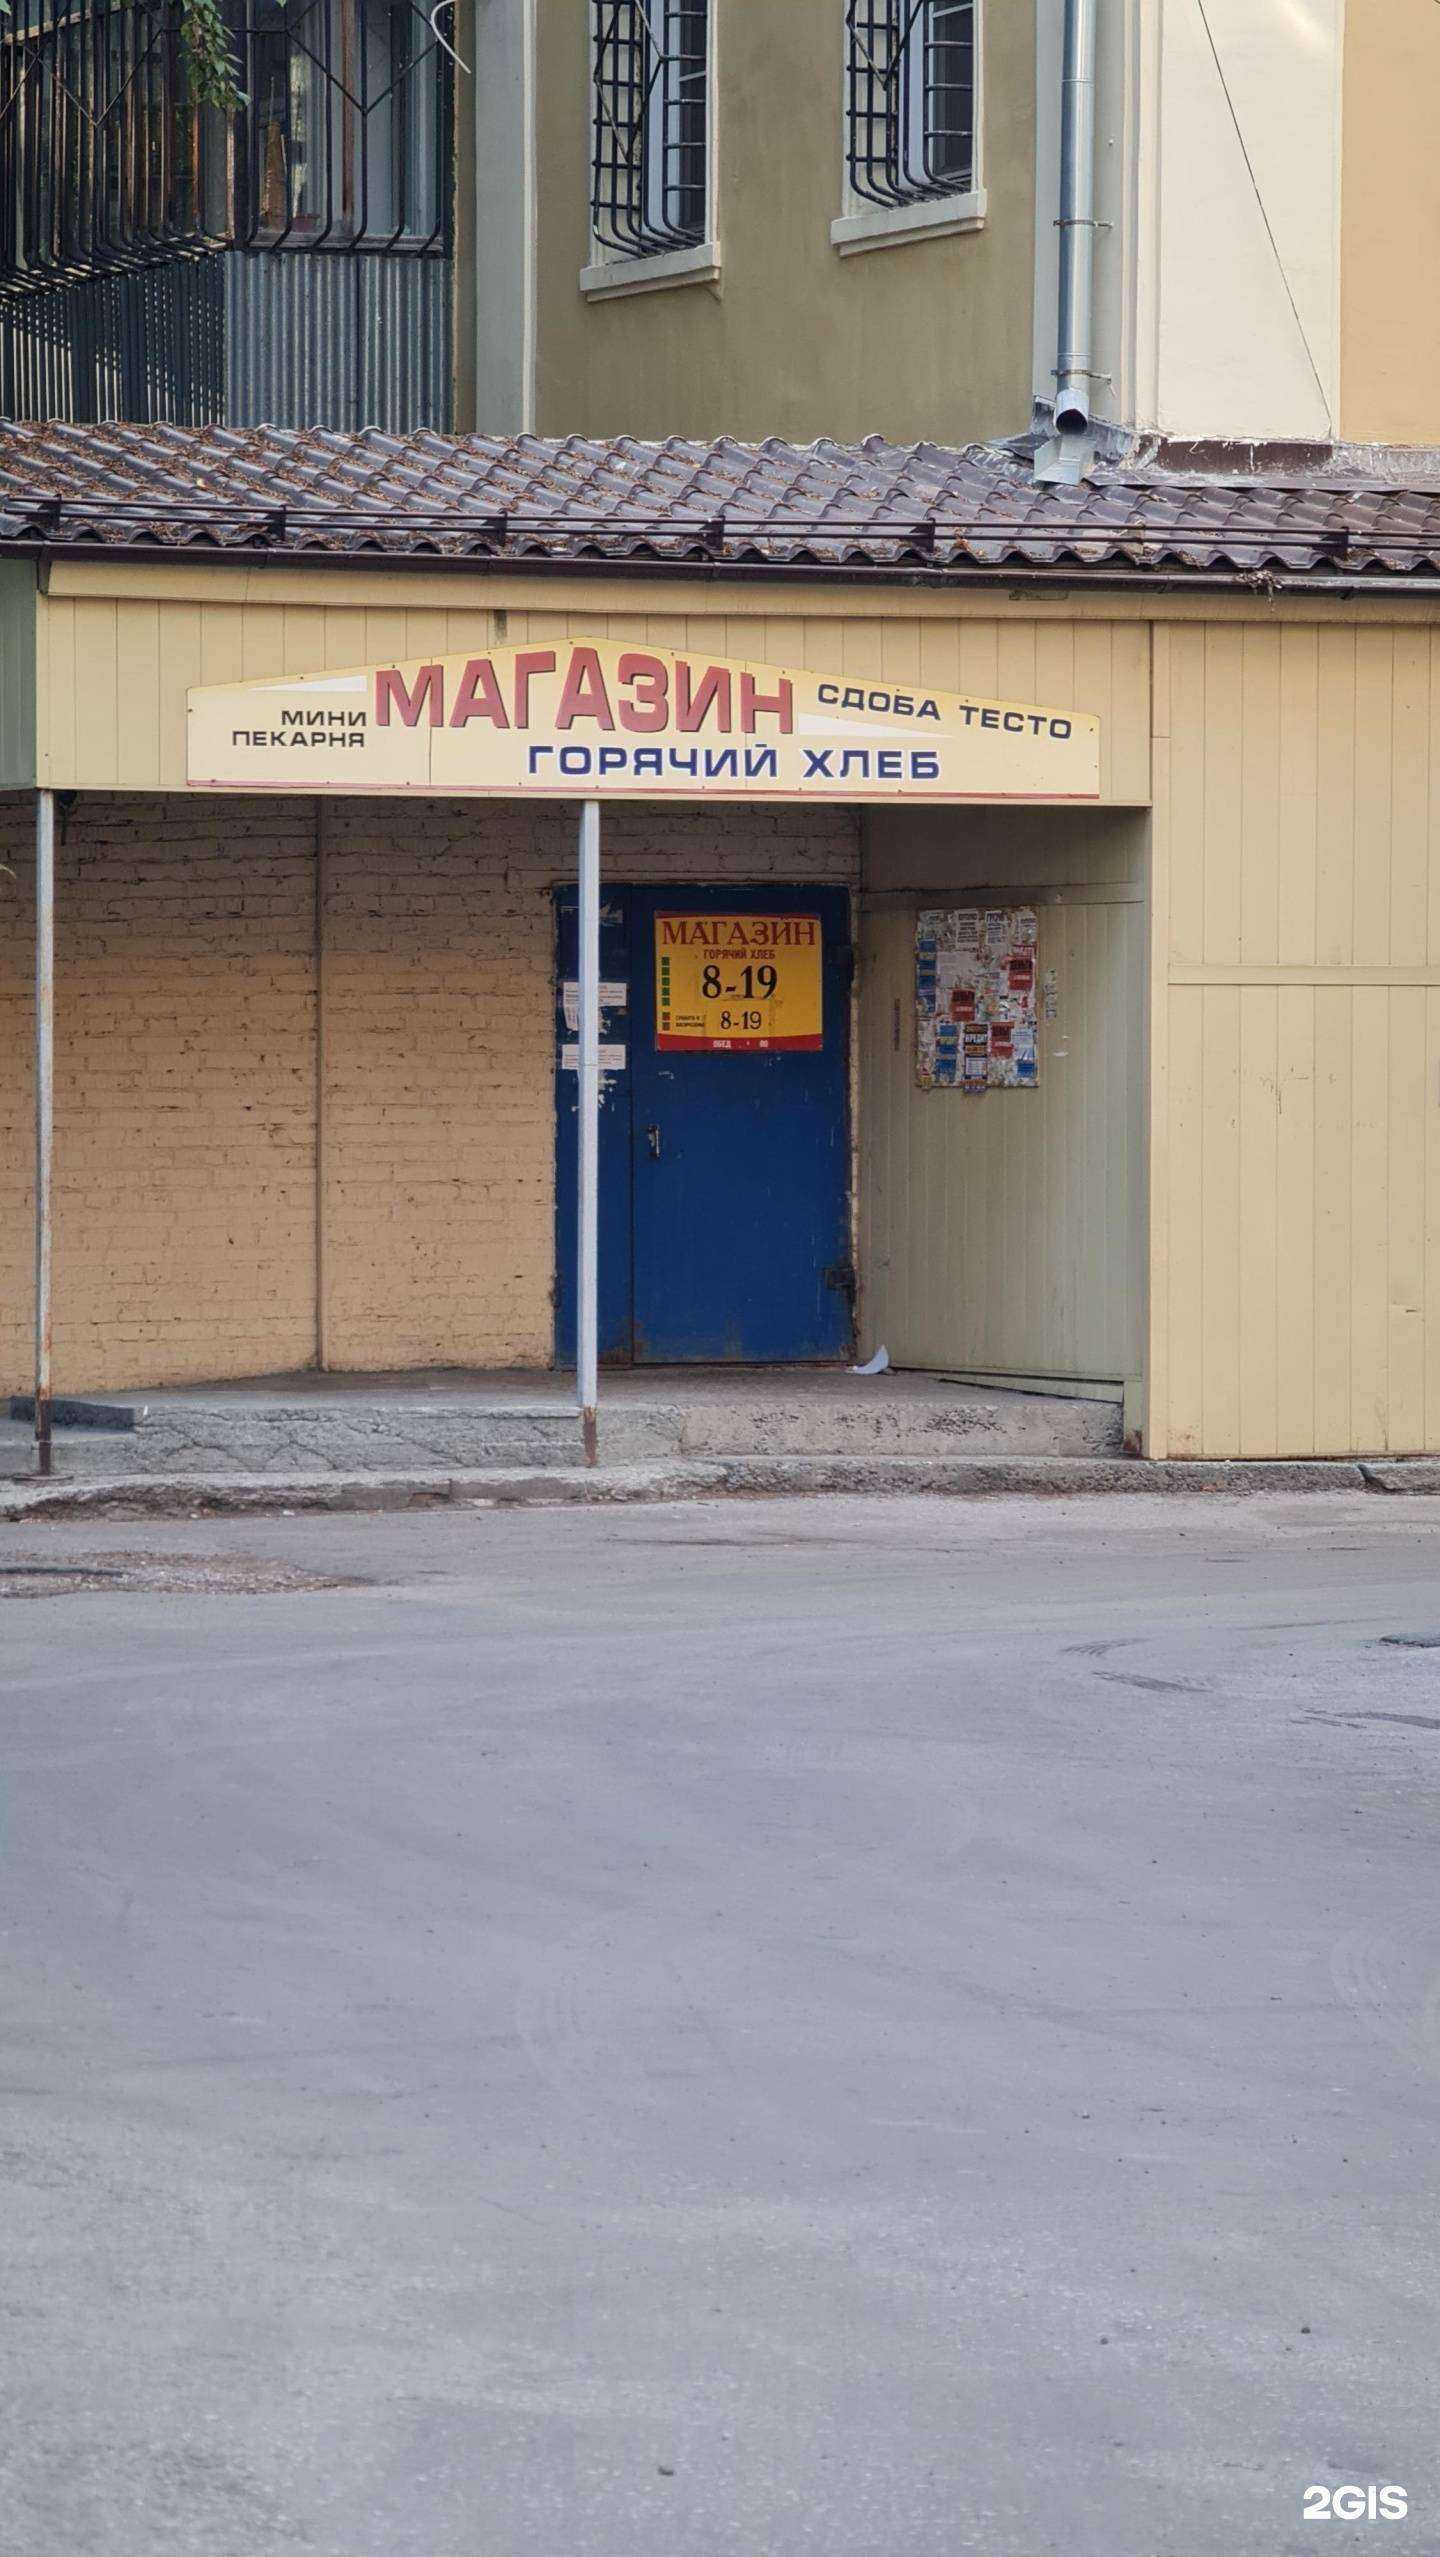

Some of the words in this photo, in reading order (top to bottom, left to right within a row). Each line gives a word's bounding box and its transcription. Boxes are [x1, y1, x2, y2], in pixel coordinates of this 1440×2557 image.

[375, 646, 794, 734] МАГАЗИН
[281, 710, 367, 727] МИНИ
[817, 683, 941, 721] СДОБА
[959, 704, 1073, 740] ТЕСТО
[232, 731, 365, 748] ПЕКАРНЯ
[529, 743, 778, 778] ГОРЯЧИЙ
[803, 749, 940, 779] ХЛЕБ
[661, 920, 816, 946] МАГАЗИН
[702, 964, 778, 999] 8-19
[720, 1010, 762, 1030] 8-19
